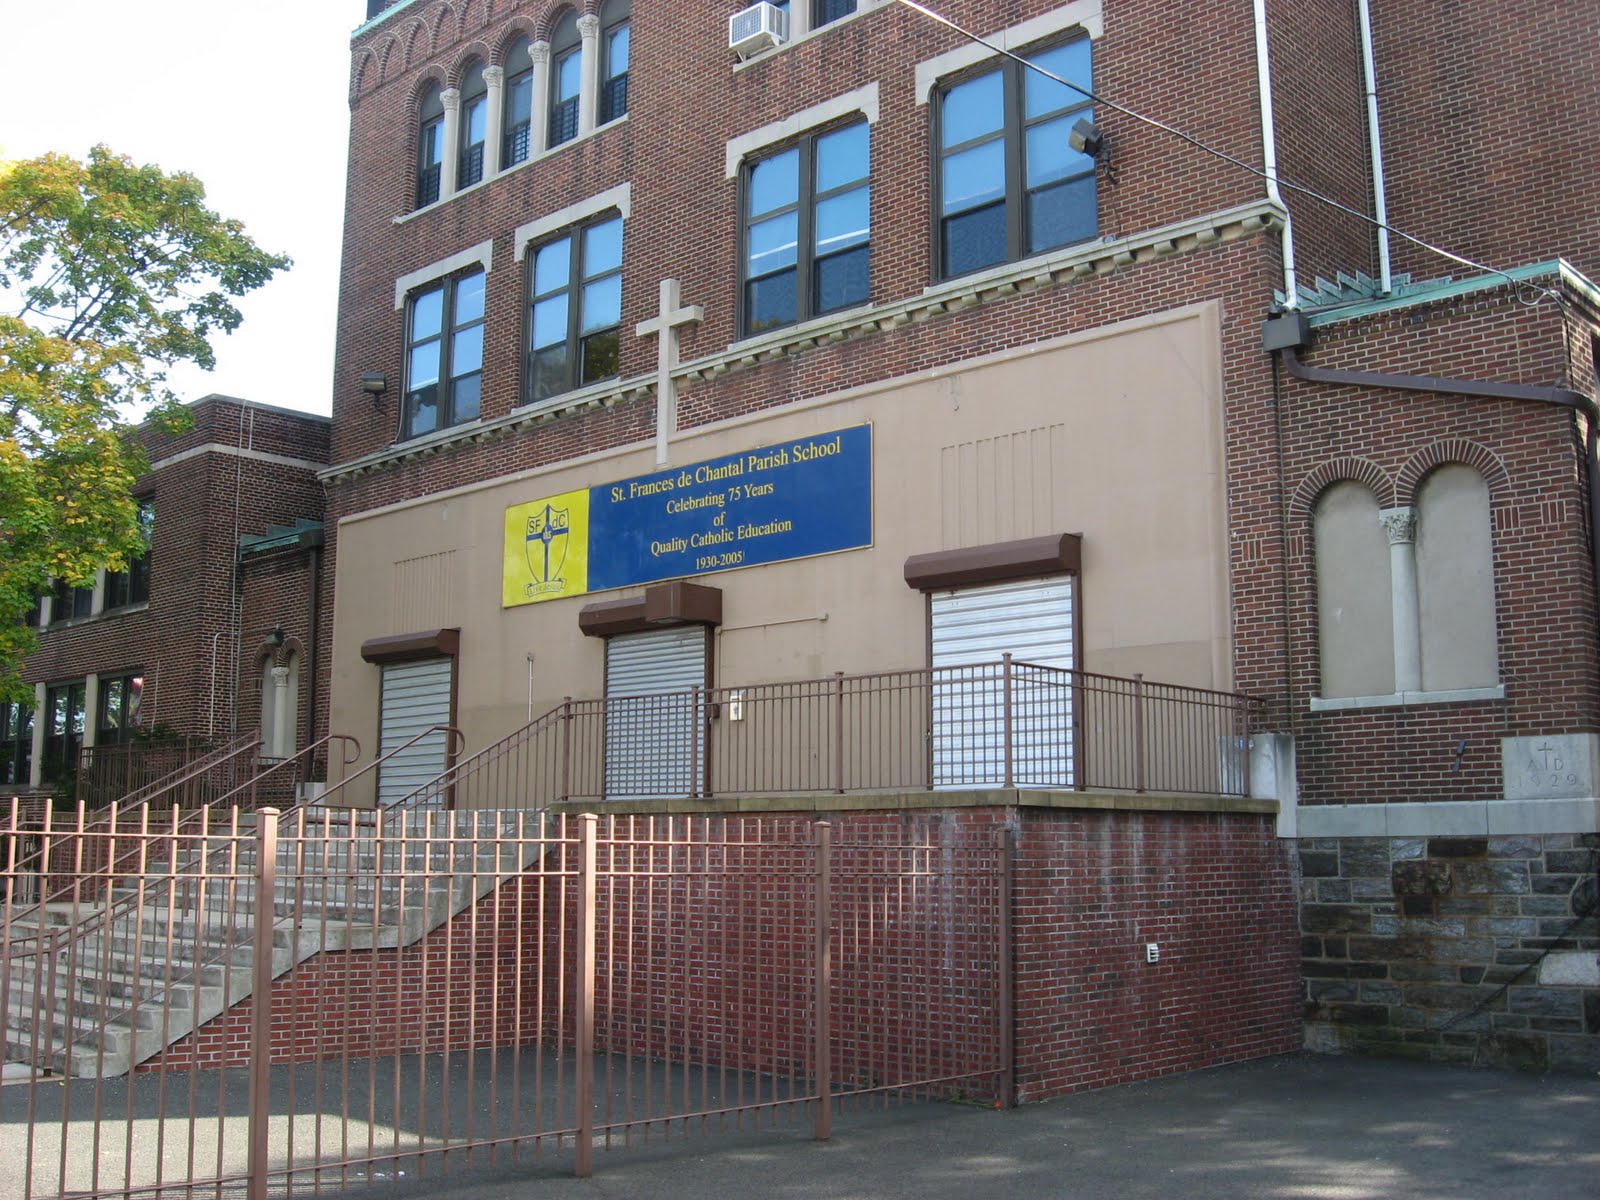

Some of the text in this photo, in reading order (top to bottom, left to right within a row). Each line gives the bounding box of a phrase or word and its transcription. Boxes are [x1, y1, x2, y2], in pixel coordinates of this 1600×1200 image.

[610, 435, 841, 503] St. Frances de Chantal Parish School
[666, 483, 774, 514] Celebrating 75 Years
[713, 511, 727, 527] of
[650, 518, 793, 557] Quality Catholic Education
[695, 550, 744, 570] 1930-2005
